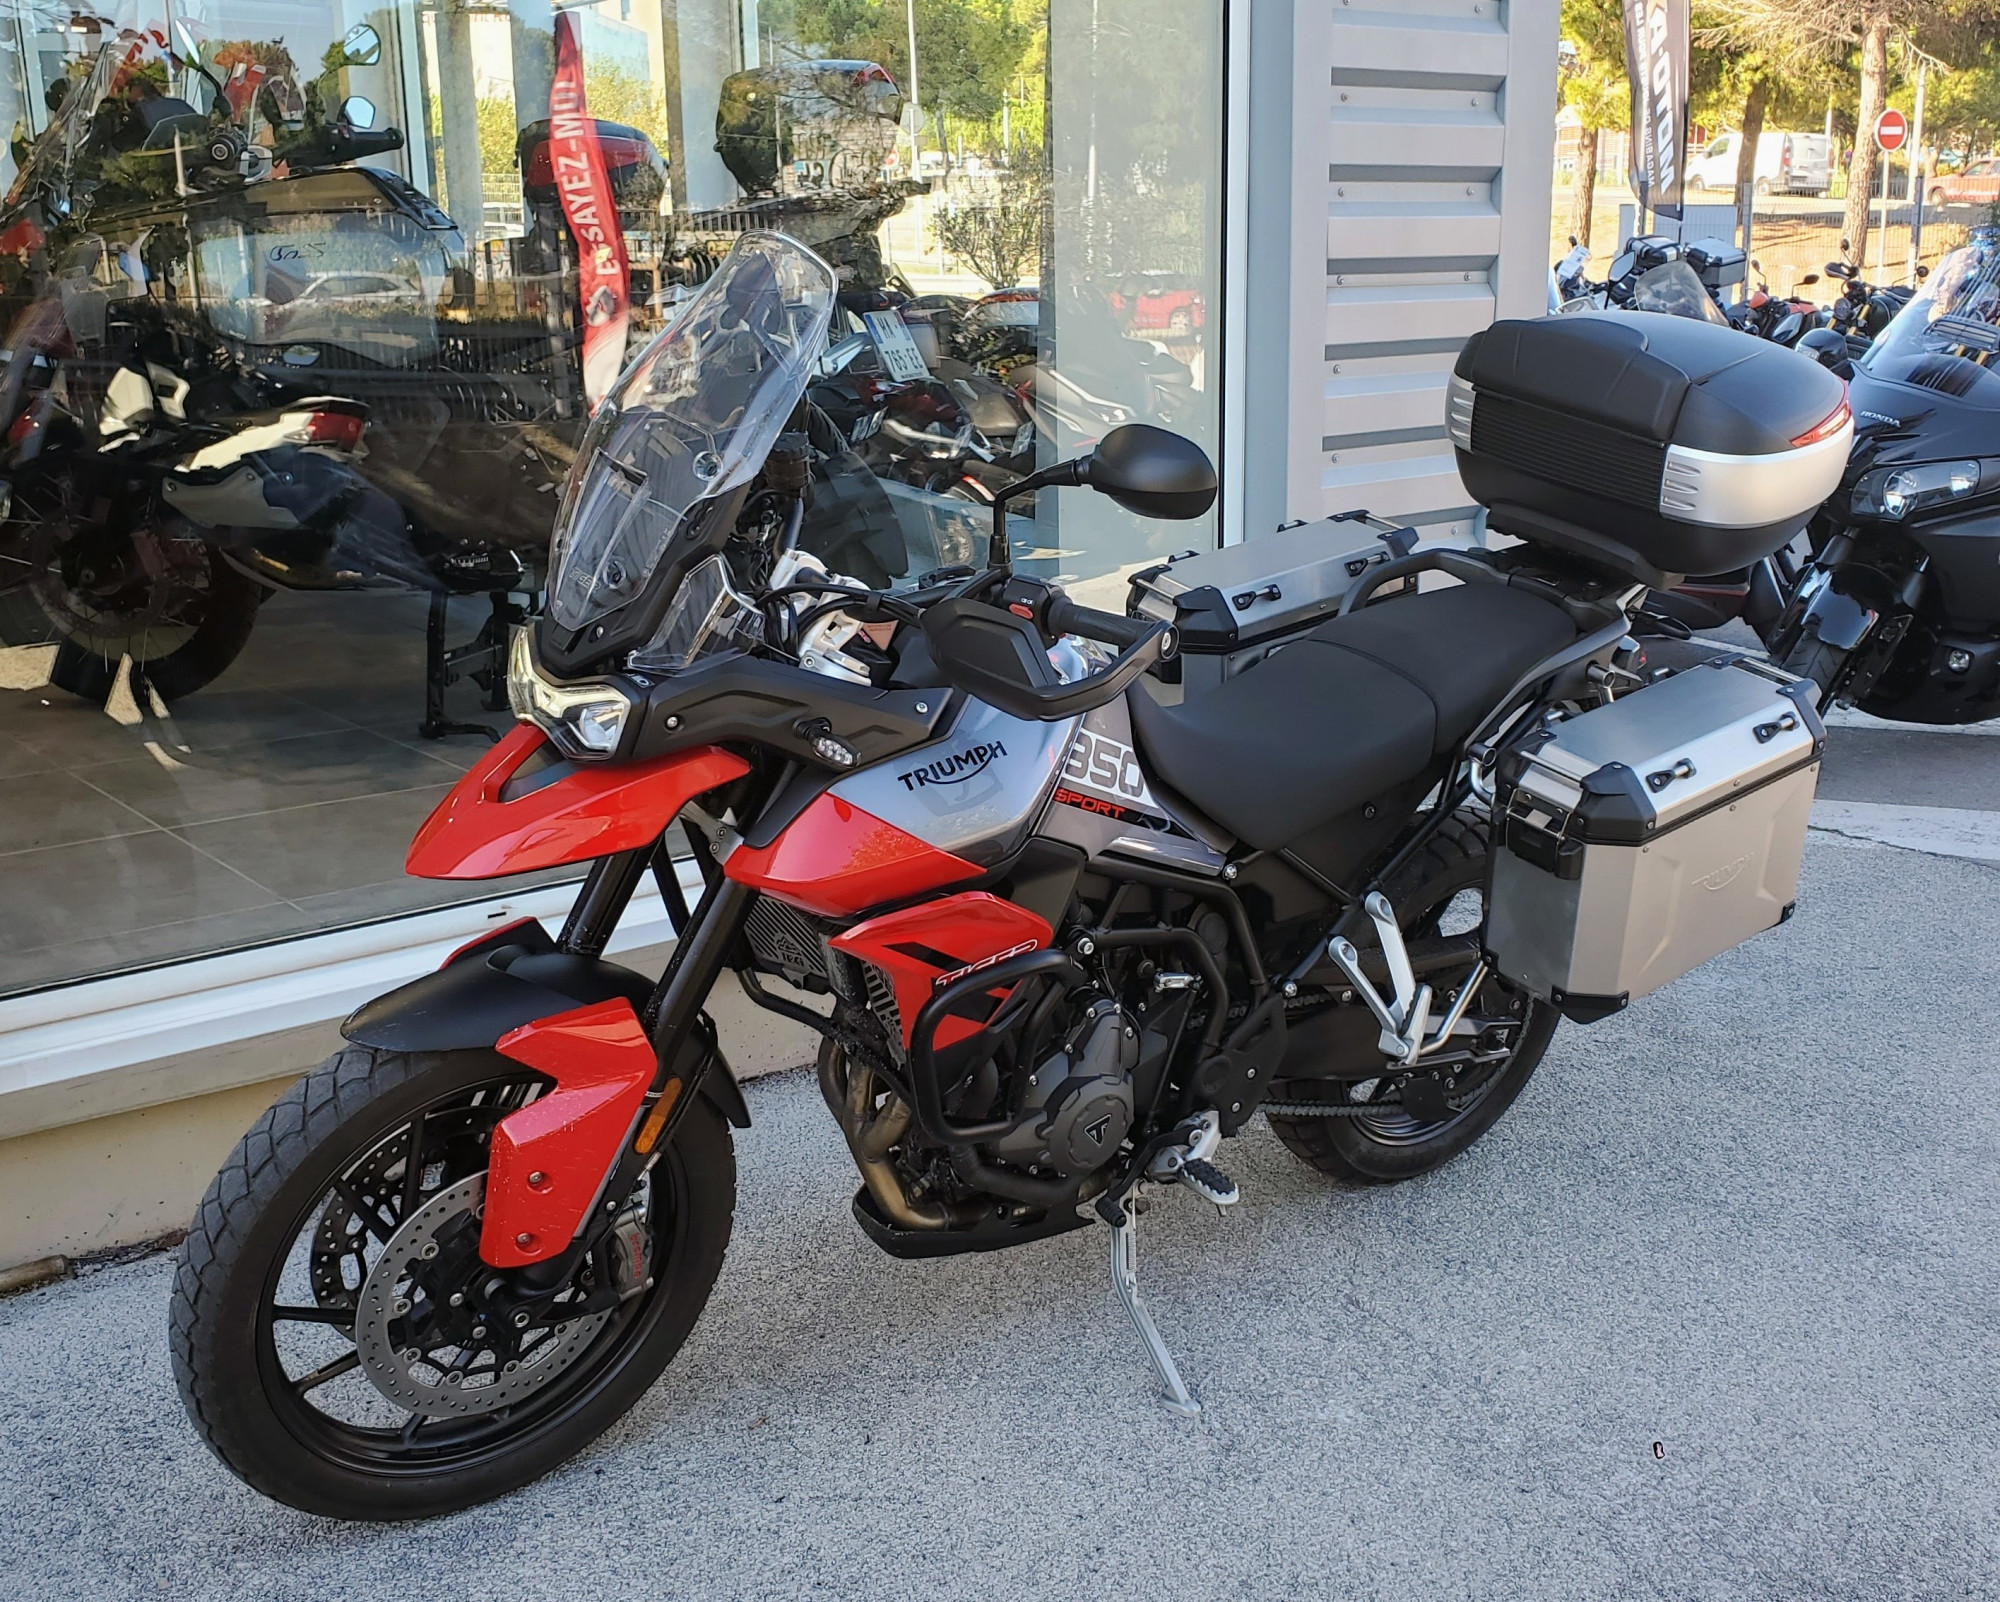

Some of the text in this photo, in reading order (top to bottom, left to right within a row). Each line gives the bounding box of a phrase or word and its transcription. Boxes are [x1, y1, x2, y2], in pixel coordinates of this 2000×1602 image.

[1860, 410, 1901, 428] HONDA
[897, 740, 1008, 792] TRIUMPH
[1055, 787, 1125, 819] SPORT
[1691, 851, 1755, 890] TRIUMPH
